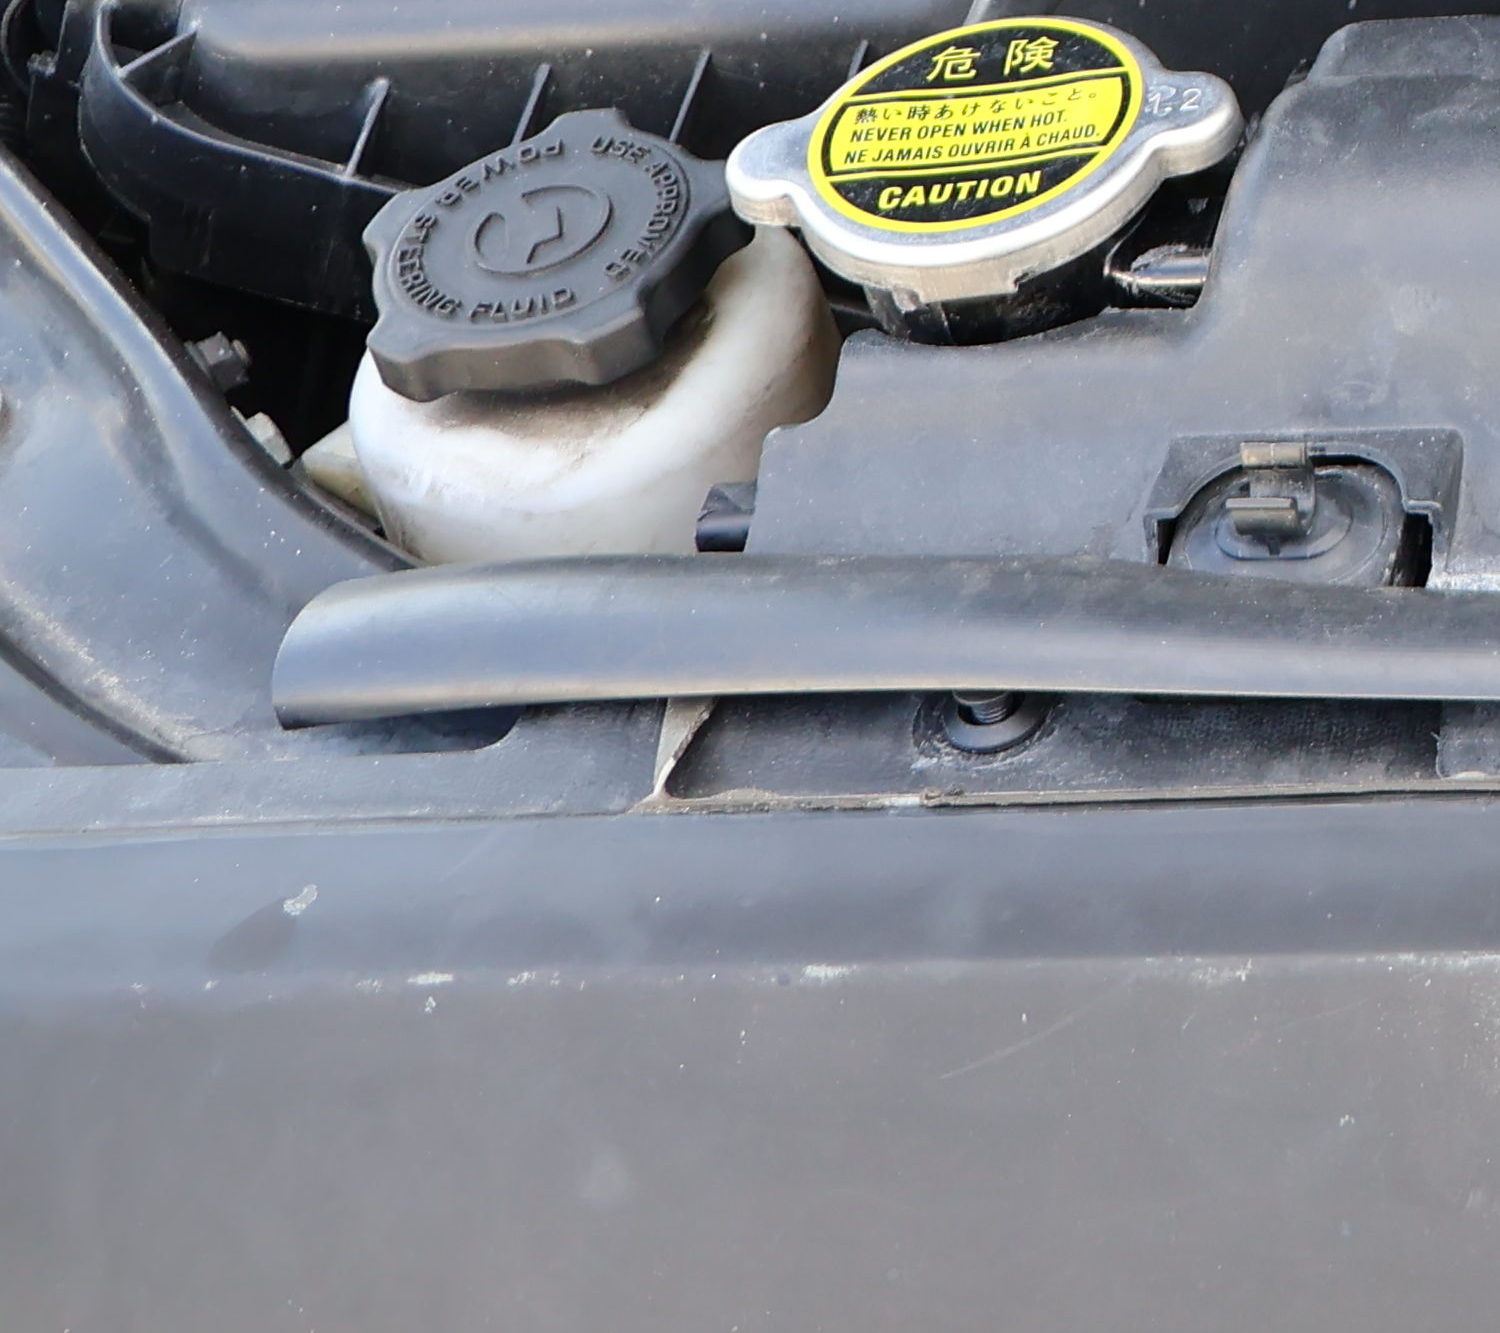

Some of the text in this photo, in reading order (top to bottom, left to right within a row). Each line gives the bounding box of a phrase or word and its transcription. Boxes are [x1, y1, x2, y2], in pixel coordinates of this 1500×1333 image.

[926, 36, 1060, 81] 危険
[850, 110, 1068, 143] NEVER OPEN WHEN HOT.
[854, 88, 1098, 125] 熱い時あけないこと。
[844, 123, 1101, 165] NE JAMAIS OUVRIR À CHAUD.
[590, 136, 682, 278] USE APPROVED
[876, 170, 1043, 211] CAUTION
[398, 137, 578, 323] POWER STEERING FLUID
